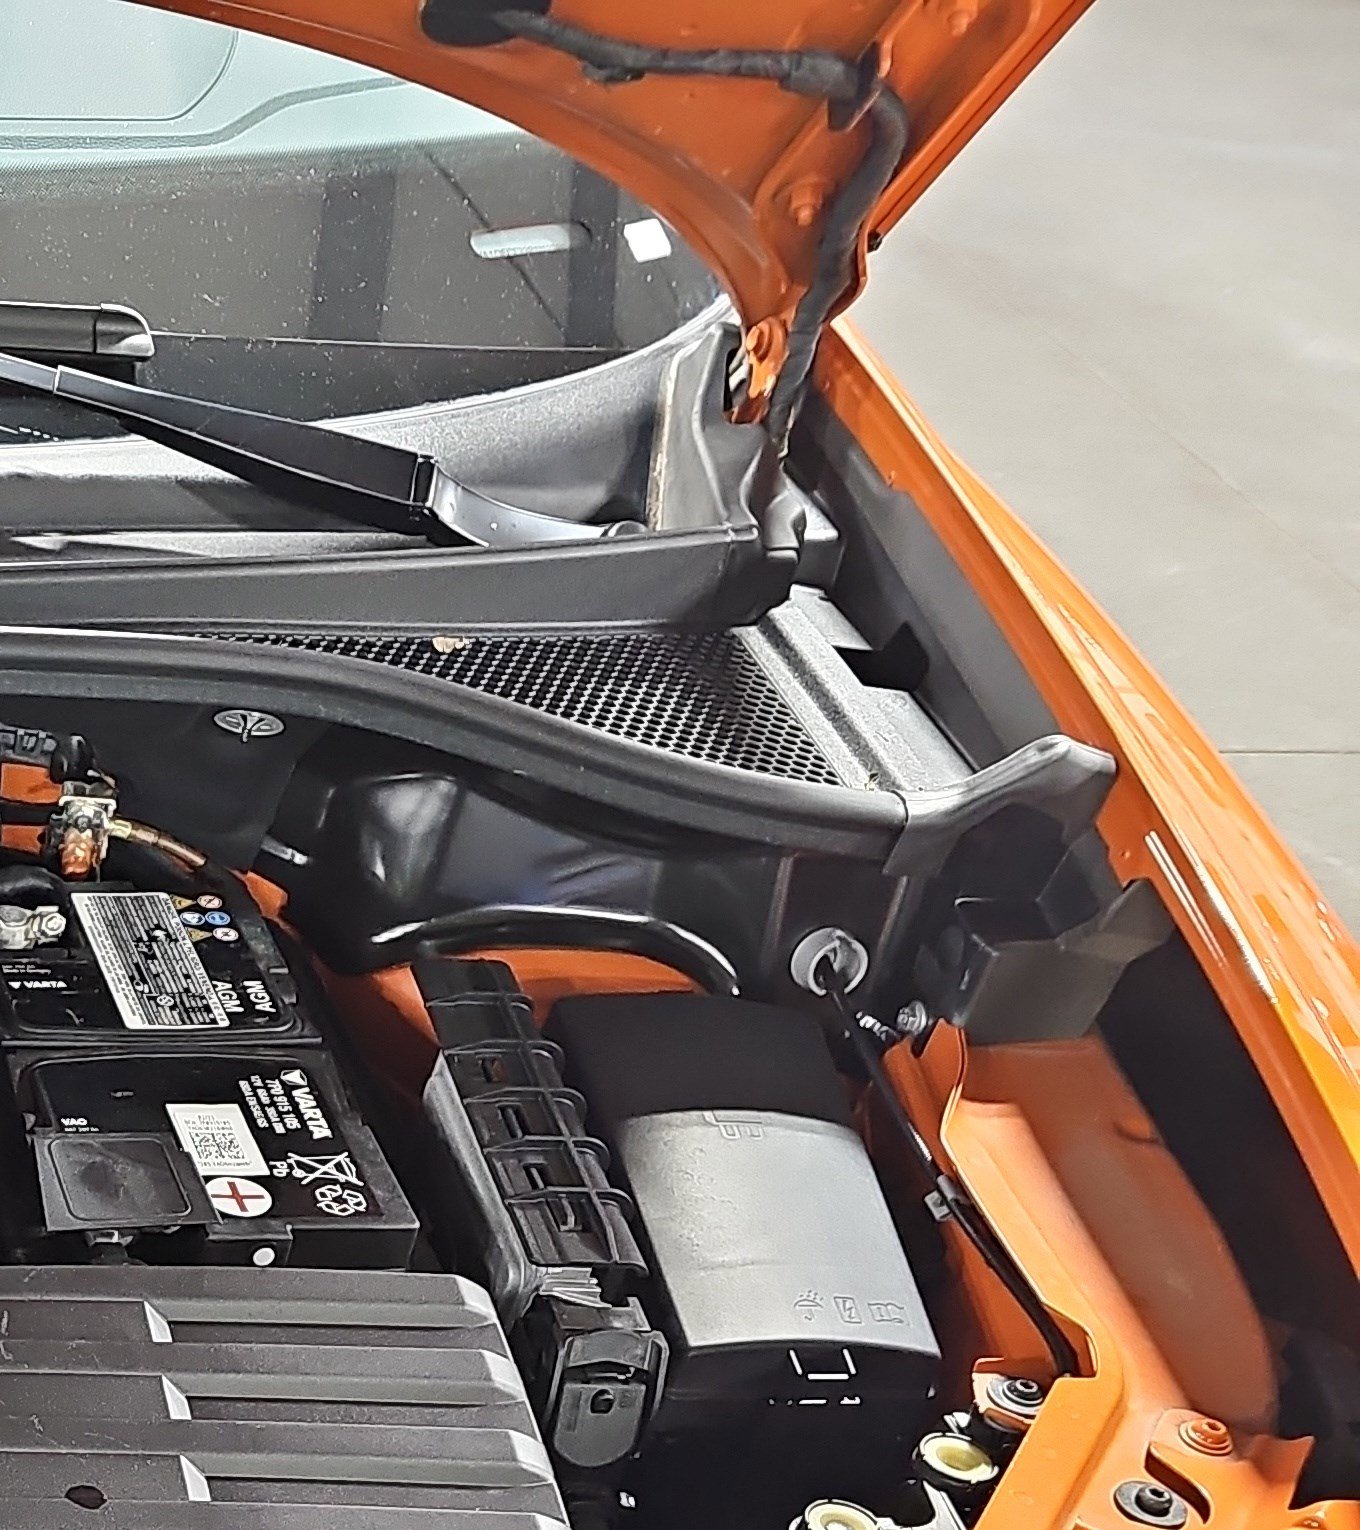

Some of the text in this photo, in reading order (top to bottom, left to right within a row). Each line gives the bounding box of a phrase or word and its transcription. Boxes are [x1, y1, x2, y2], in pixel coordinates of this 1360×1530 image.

[212, 980, 244, 1013] AGM
[243, 980, 277, 1013] AGM
[291, 1086, 333, 1140] VARTA
[269, 1160, 291, 1178] Pb
